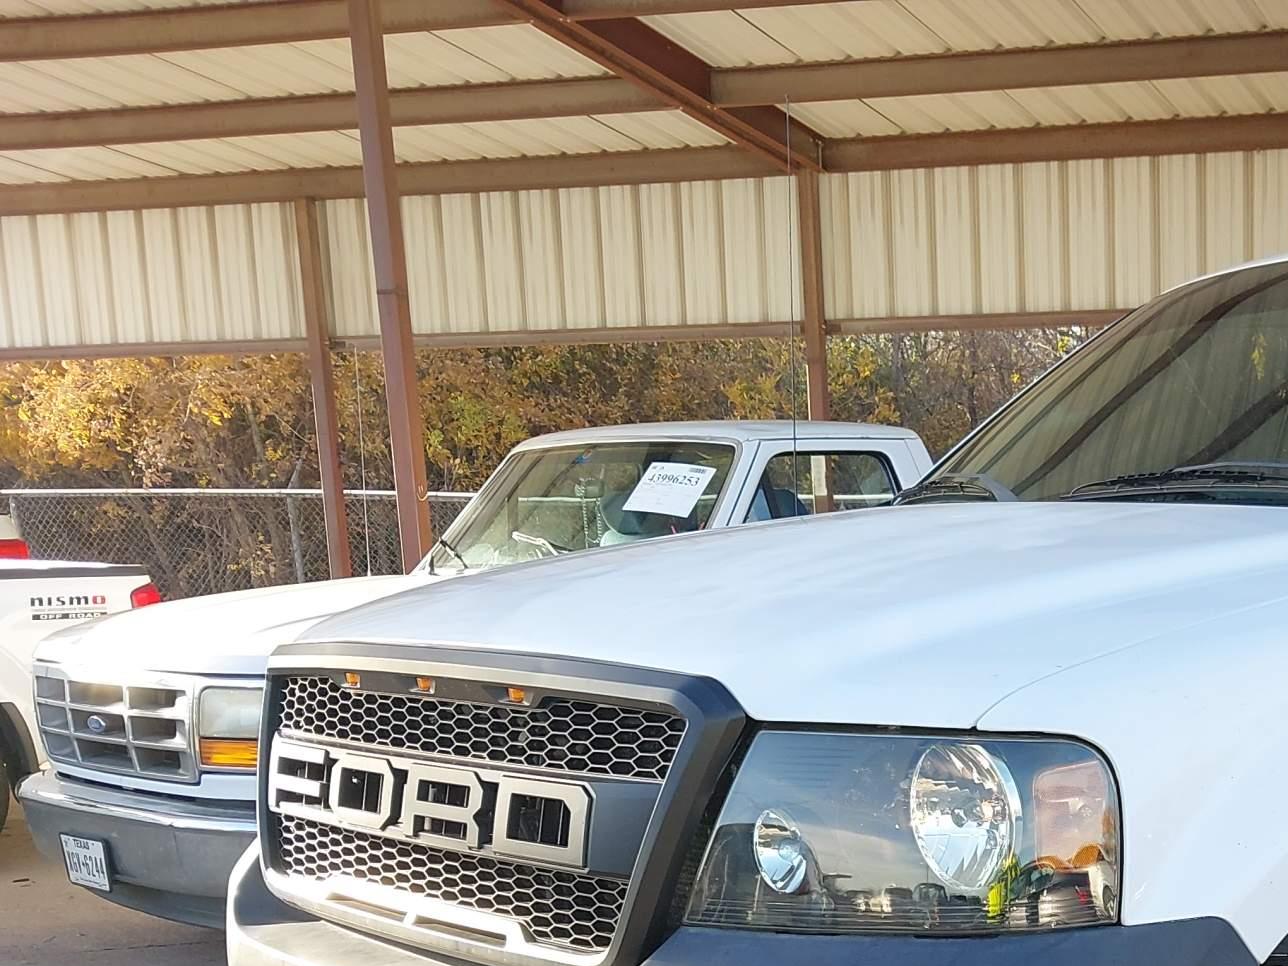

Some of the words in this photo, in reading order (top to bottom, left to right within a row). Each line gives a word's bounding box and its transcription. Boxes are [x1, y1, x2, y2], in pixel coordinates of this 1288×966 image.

[648, 473, 700, 487] 43996253
[269, 733, 597, 873] FORD
[72, 838, 90, 850] TEXAS
